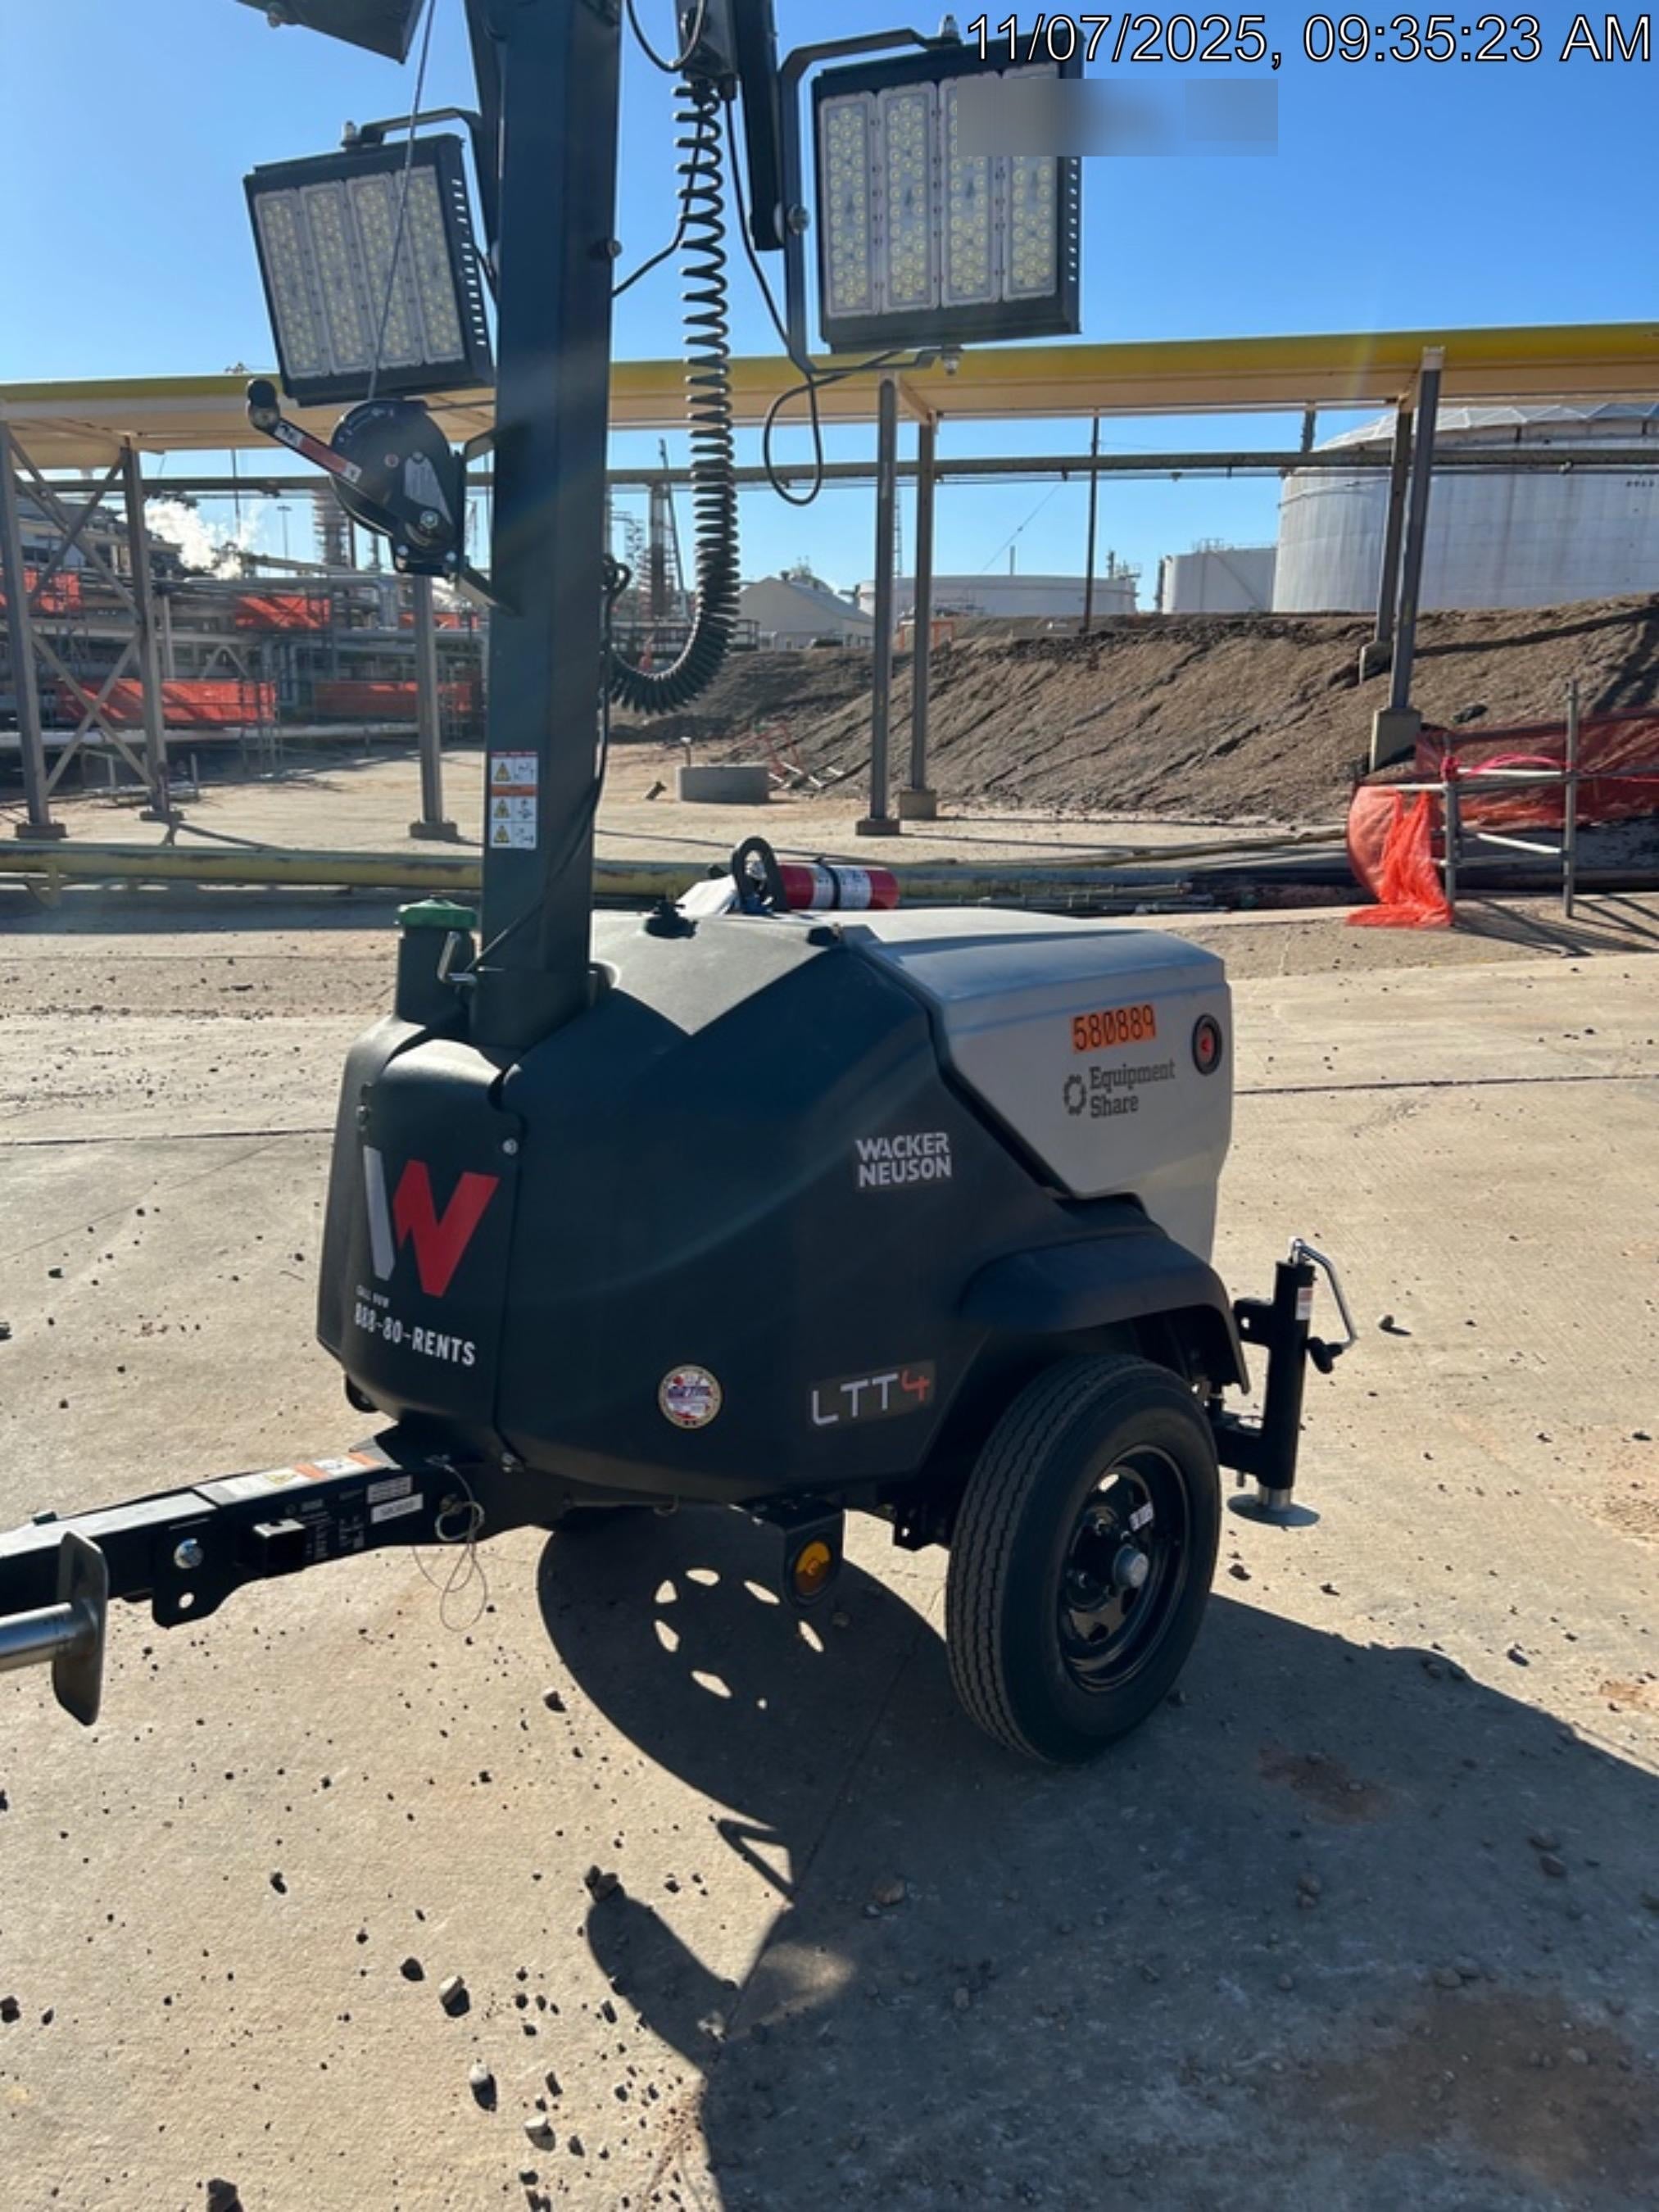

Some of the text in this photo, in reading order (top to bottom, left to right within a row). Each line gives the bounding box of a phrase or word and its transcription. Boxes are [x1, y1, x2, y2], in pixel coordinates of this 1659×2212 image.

[1073, 1004, 1156, 1050] 580889
[1089, 1058, 1176, 1093] Equipment
[1090, 1095, 1139, 1118] Share
[855, 1131, 950, 1162] WACKER
[859, 1154, 952, 1188] NEUSON
[354, 1301, 476, 1367] 888-80-RENTS
[811, 1368, 931, 1426] LTT4
